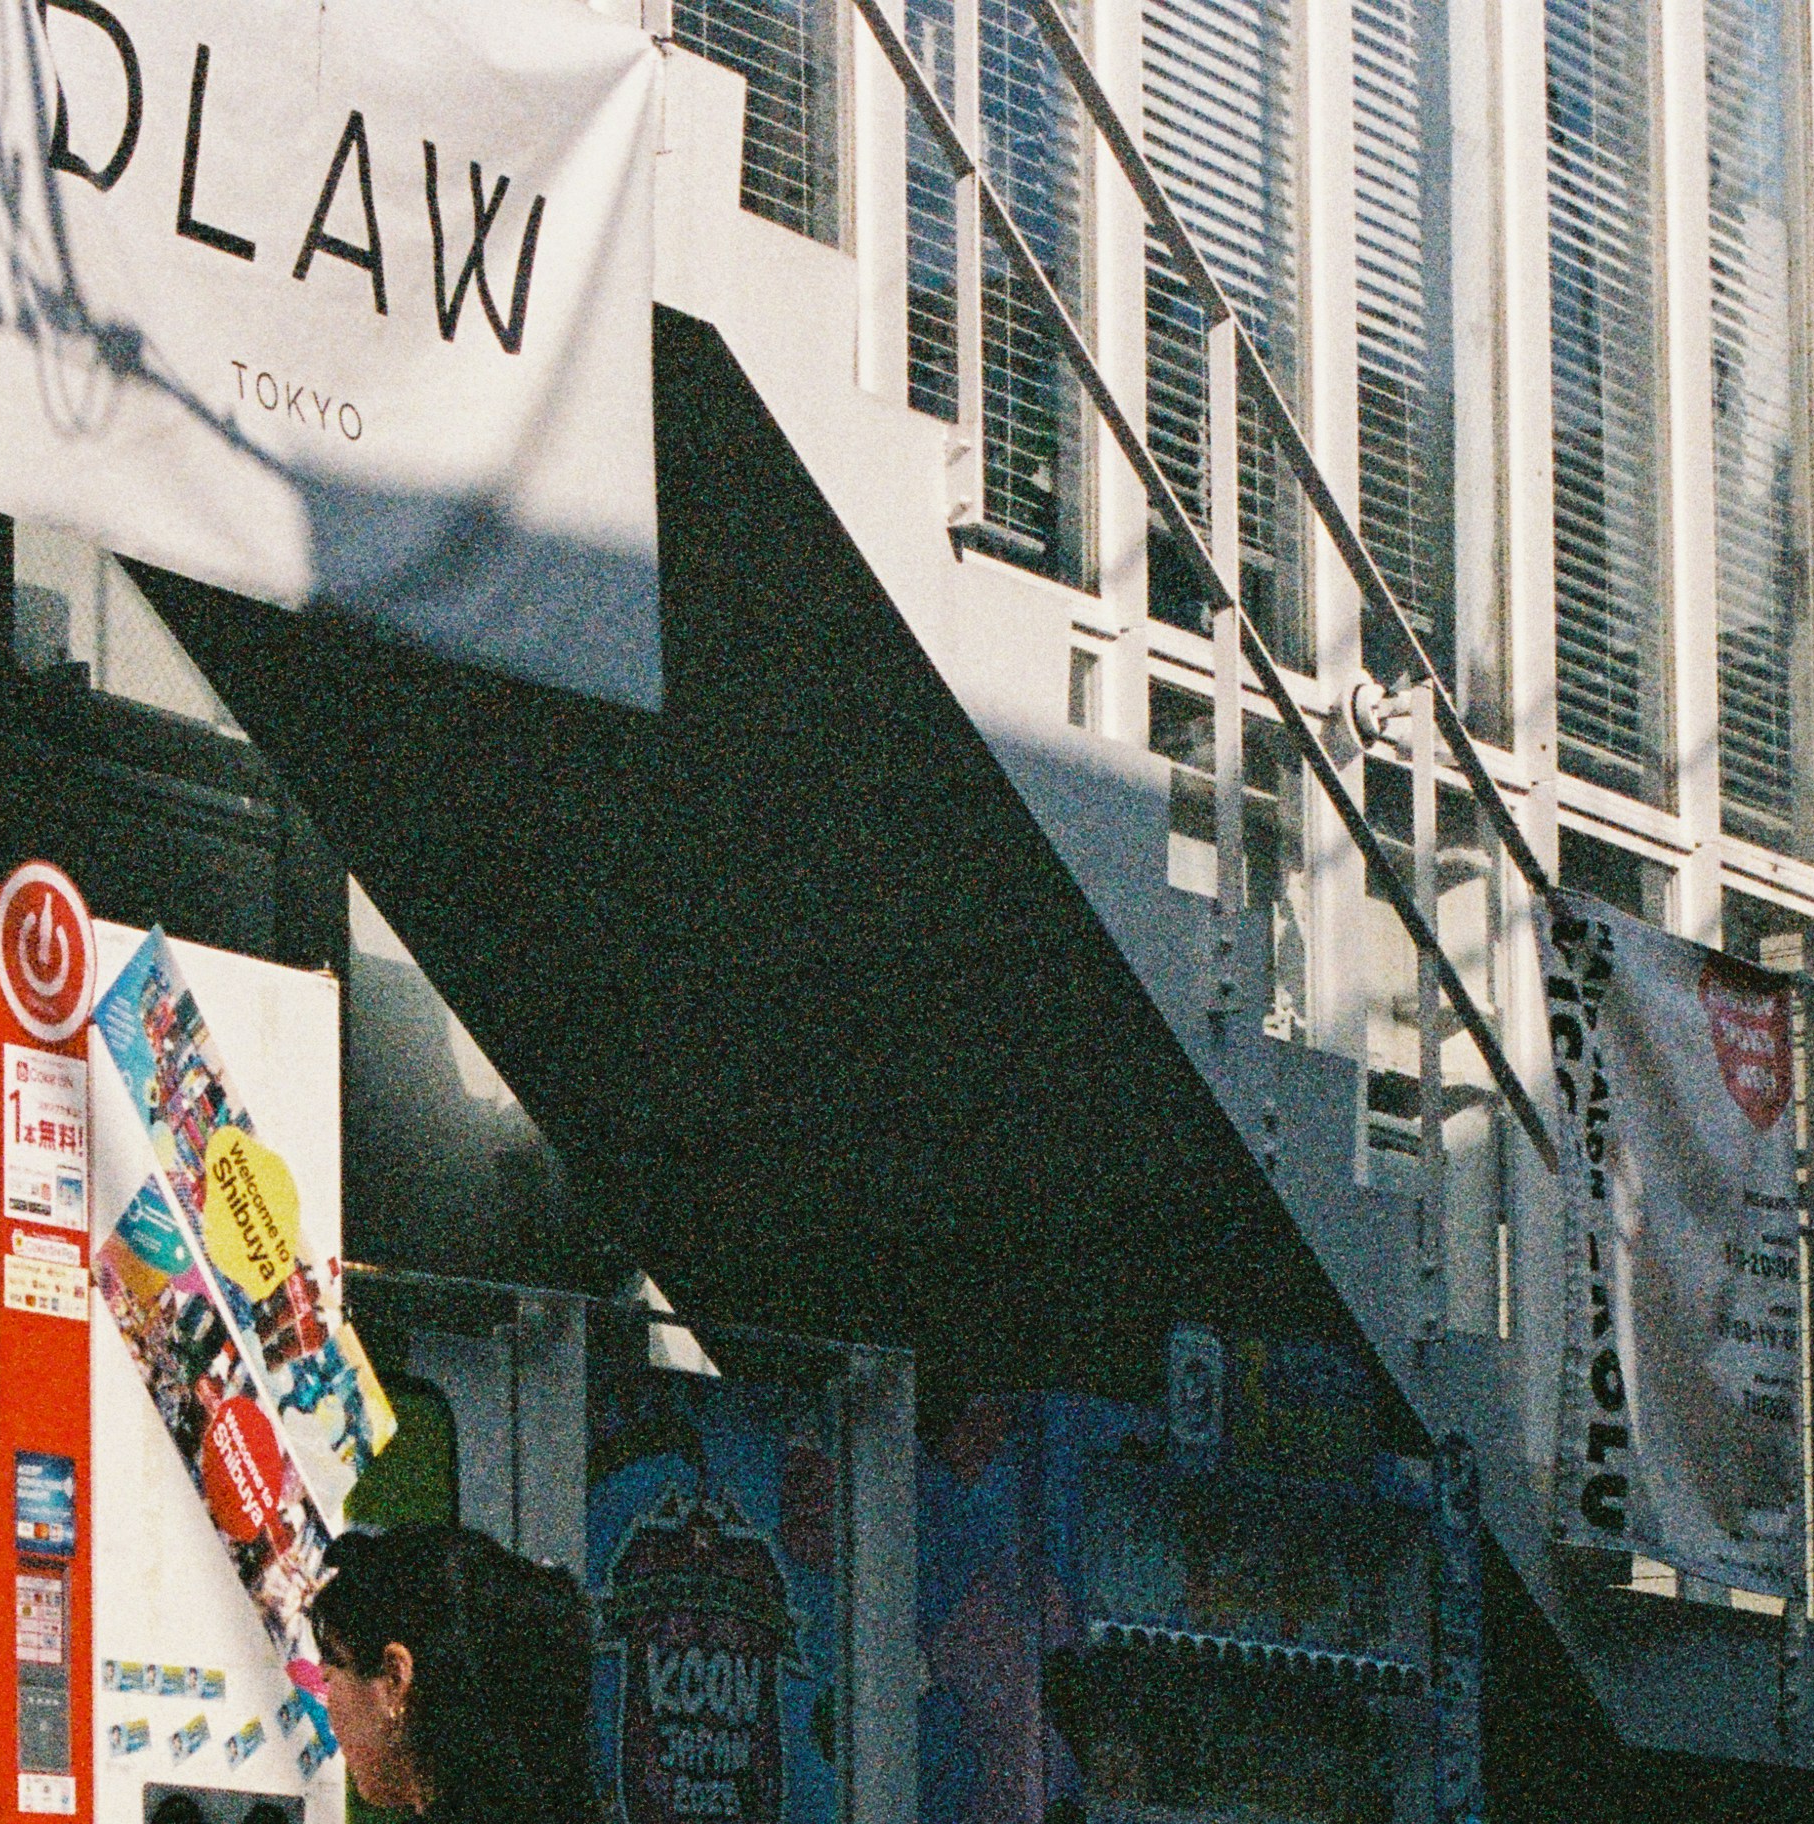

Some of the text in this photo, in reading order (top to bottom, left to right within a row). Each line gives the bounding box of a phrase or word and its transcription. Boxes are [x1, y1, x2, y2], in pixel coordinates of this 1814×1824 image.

[230, 360, 363, 441] TOKYO
[213, 1157, 278, 1282] Shibuya
[229, 1141, 290, 1264] Welcome to
[212, 1424, 263, 1528] Shibuya
[224, 1408, 274, 1510] Welcome to
[645, 1641, 762, 1724] KCON
[659, 1722, 752, 1773] JAPAN
